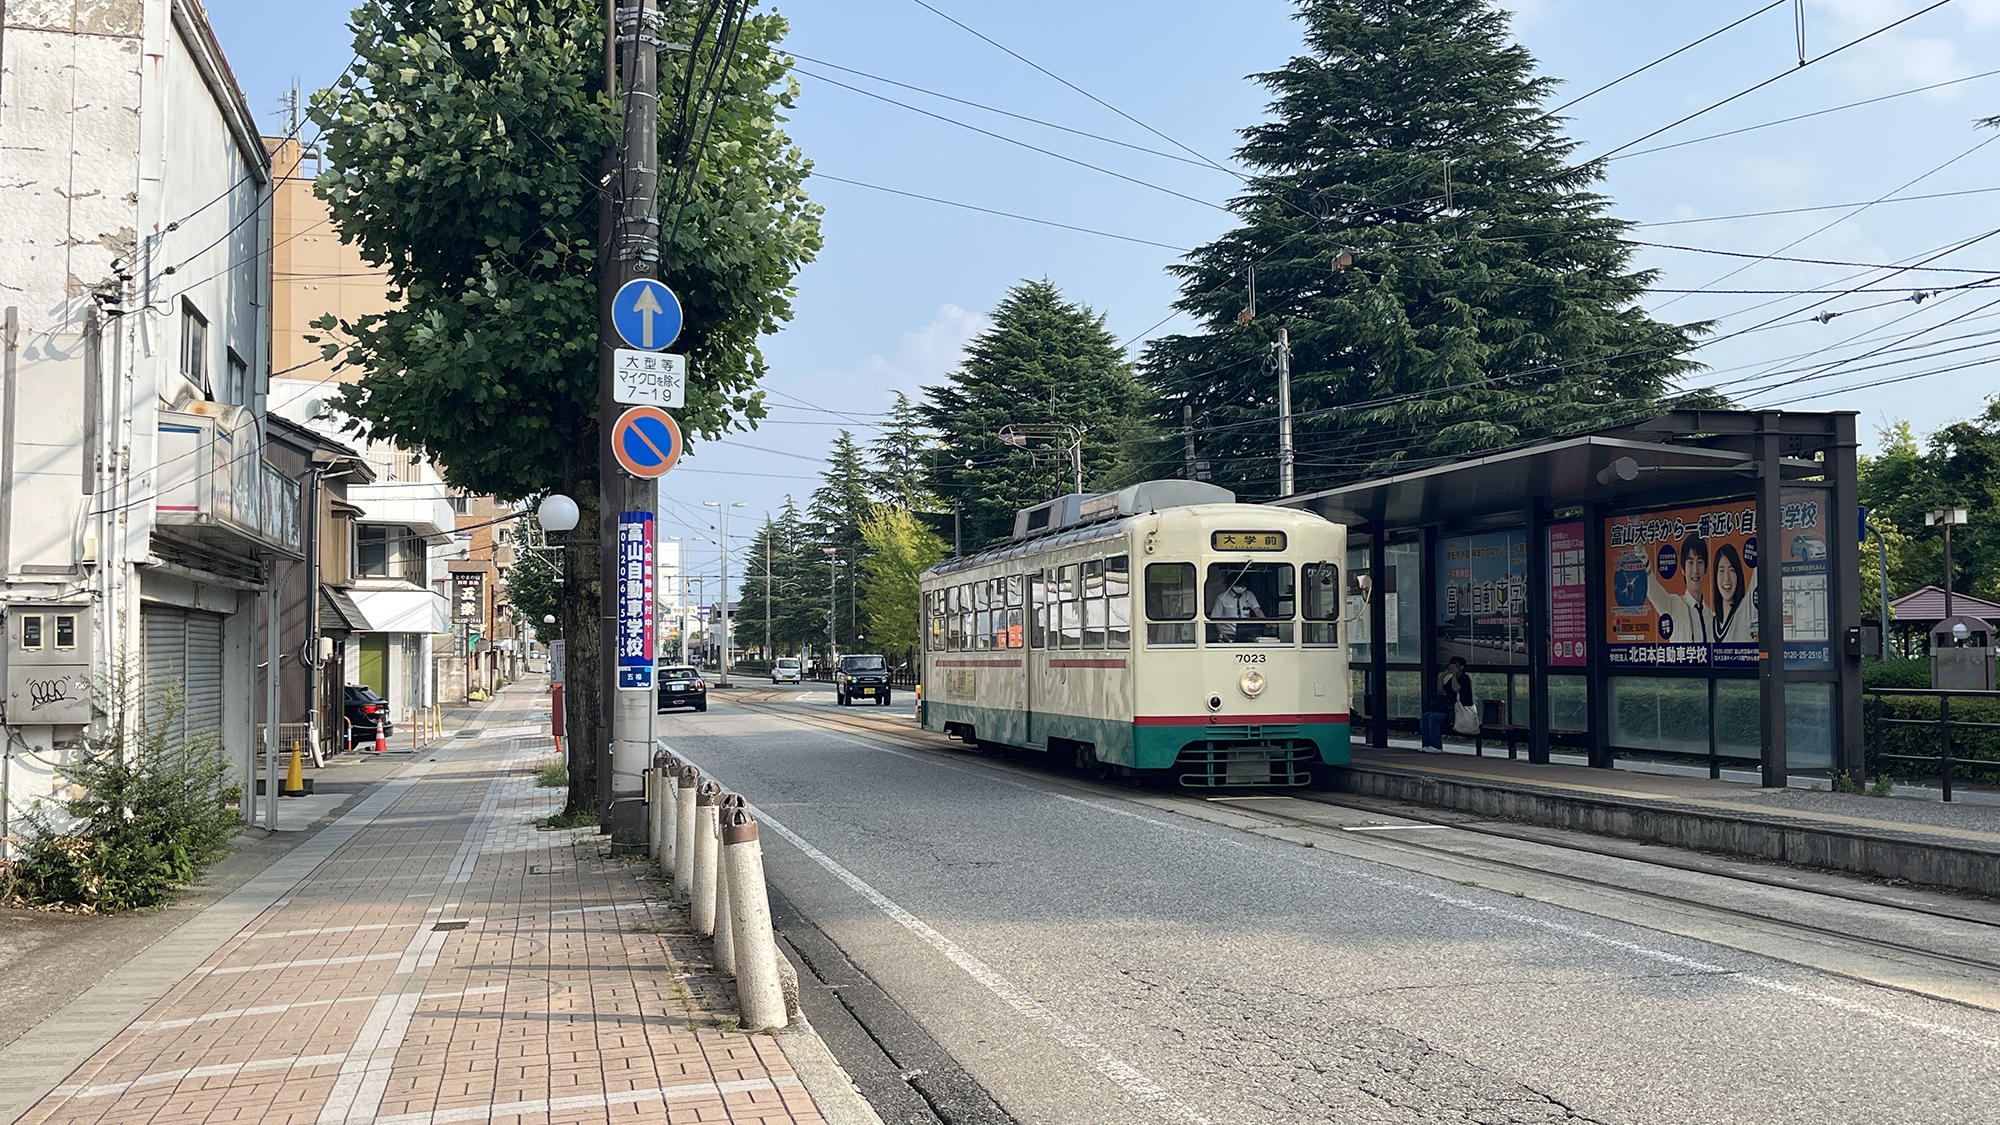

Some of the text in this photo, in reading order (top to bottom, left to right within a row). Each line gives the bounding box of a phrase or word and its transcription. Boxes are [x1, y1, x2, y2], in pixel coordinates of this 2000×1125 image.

[626, 355, 674, 372] 大型等
[619, 370, 681, 388] マイクロを除く
[1223, 535, 1277, 546] 大学前
[627, 522, 643, 657] 富山自動車学校
[1235, 654, 1267, 663] 7023
[1629, 646, 1708, 664] 北日本自動車学校
[1783, 651, 1822, 659] 0120-25-2510
